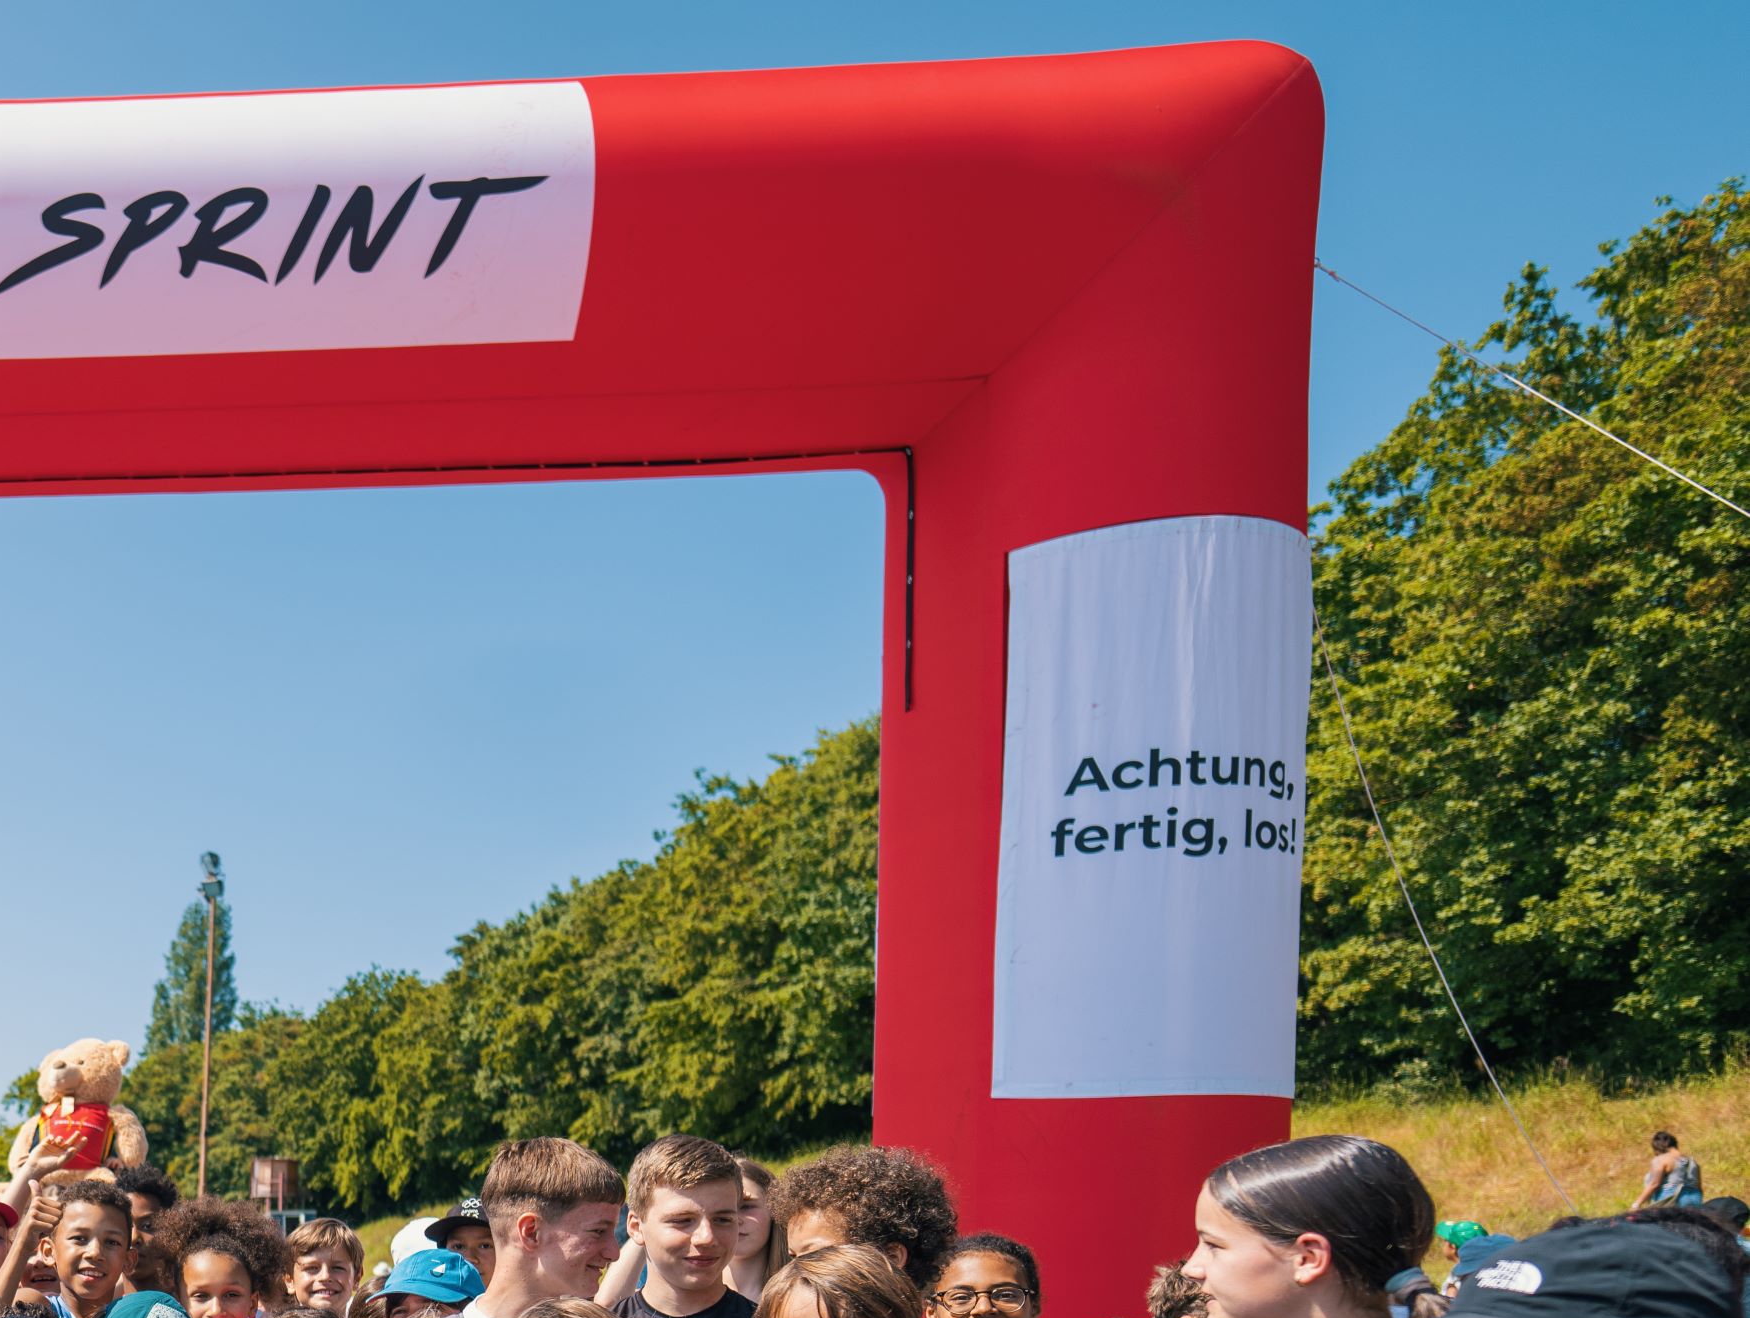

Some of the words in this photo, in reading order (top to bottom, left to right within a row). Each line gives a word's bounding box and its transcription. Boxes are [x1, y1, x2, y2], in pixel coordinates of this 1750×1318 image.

[1064, 748, 1294, 800] Achtung,
[1051, 806, 1228, 858] fertig,
[1245, 808, 1296, 855] los!
